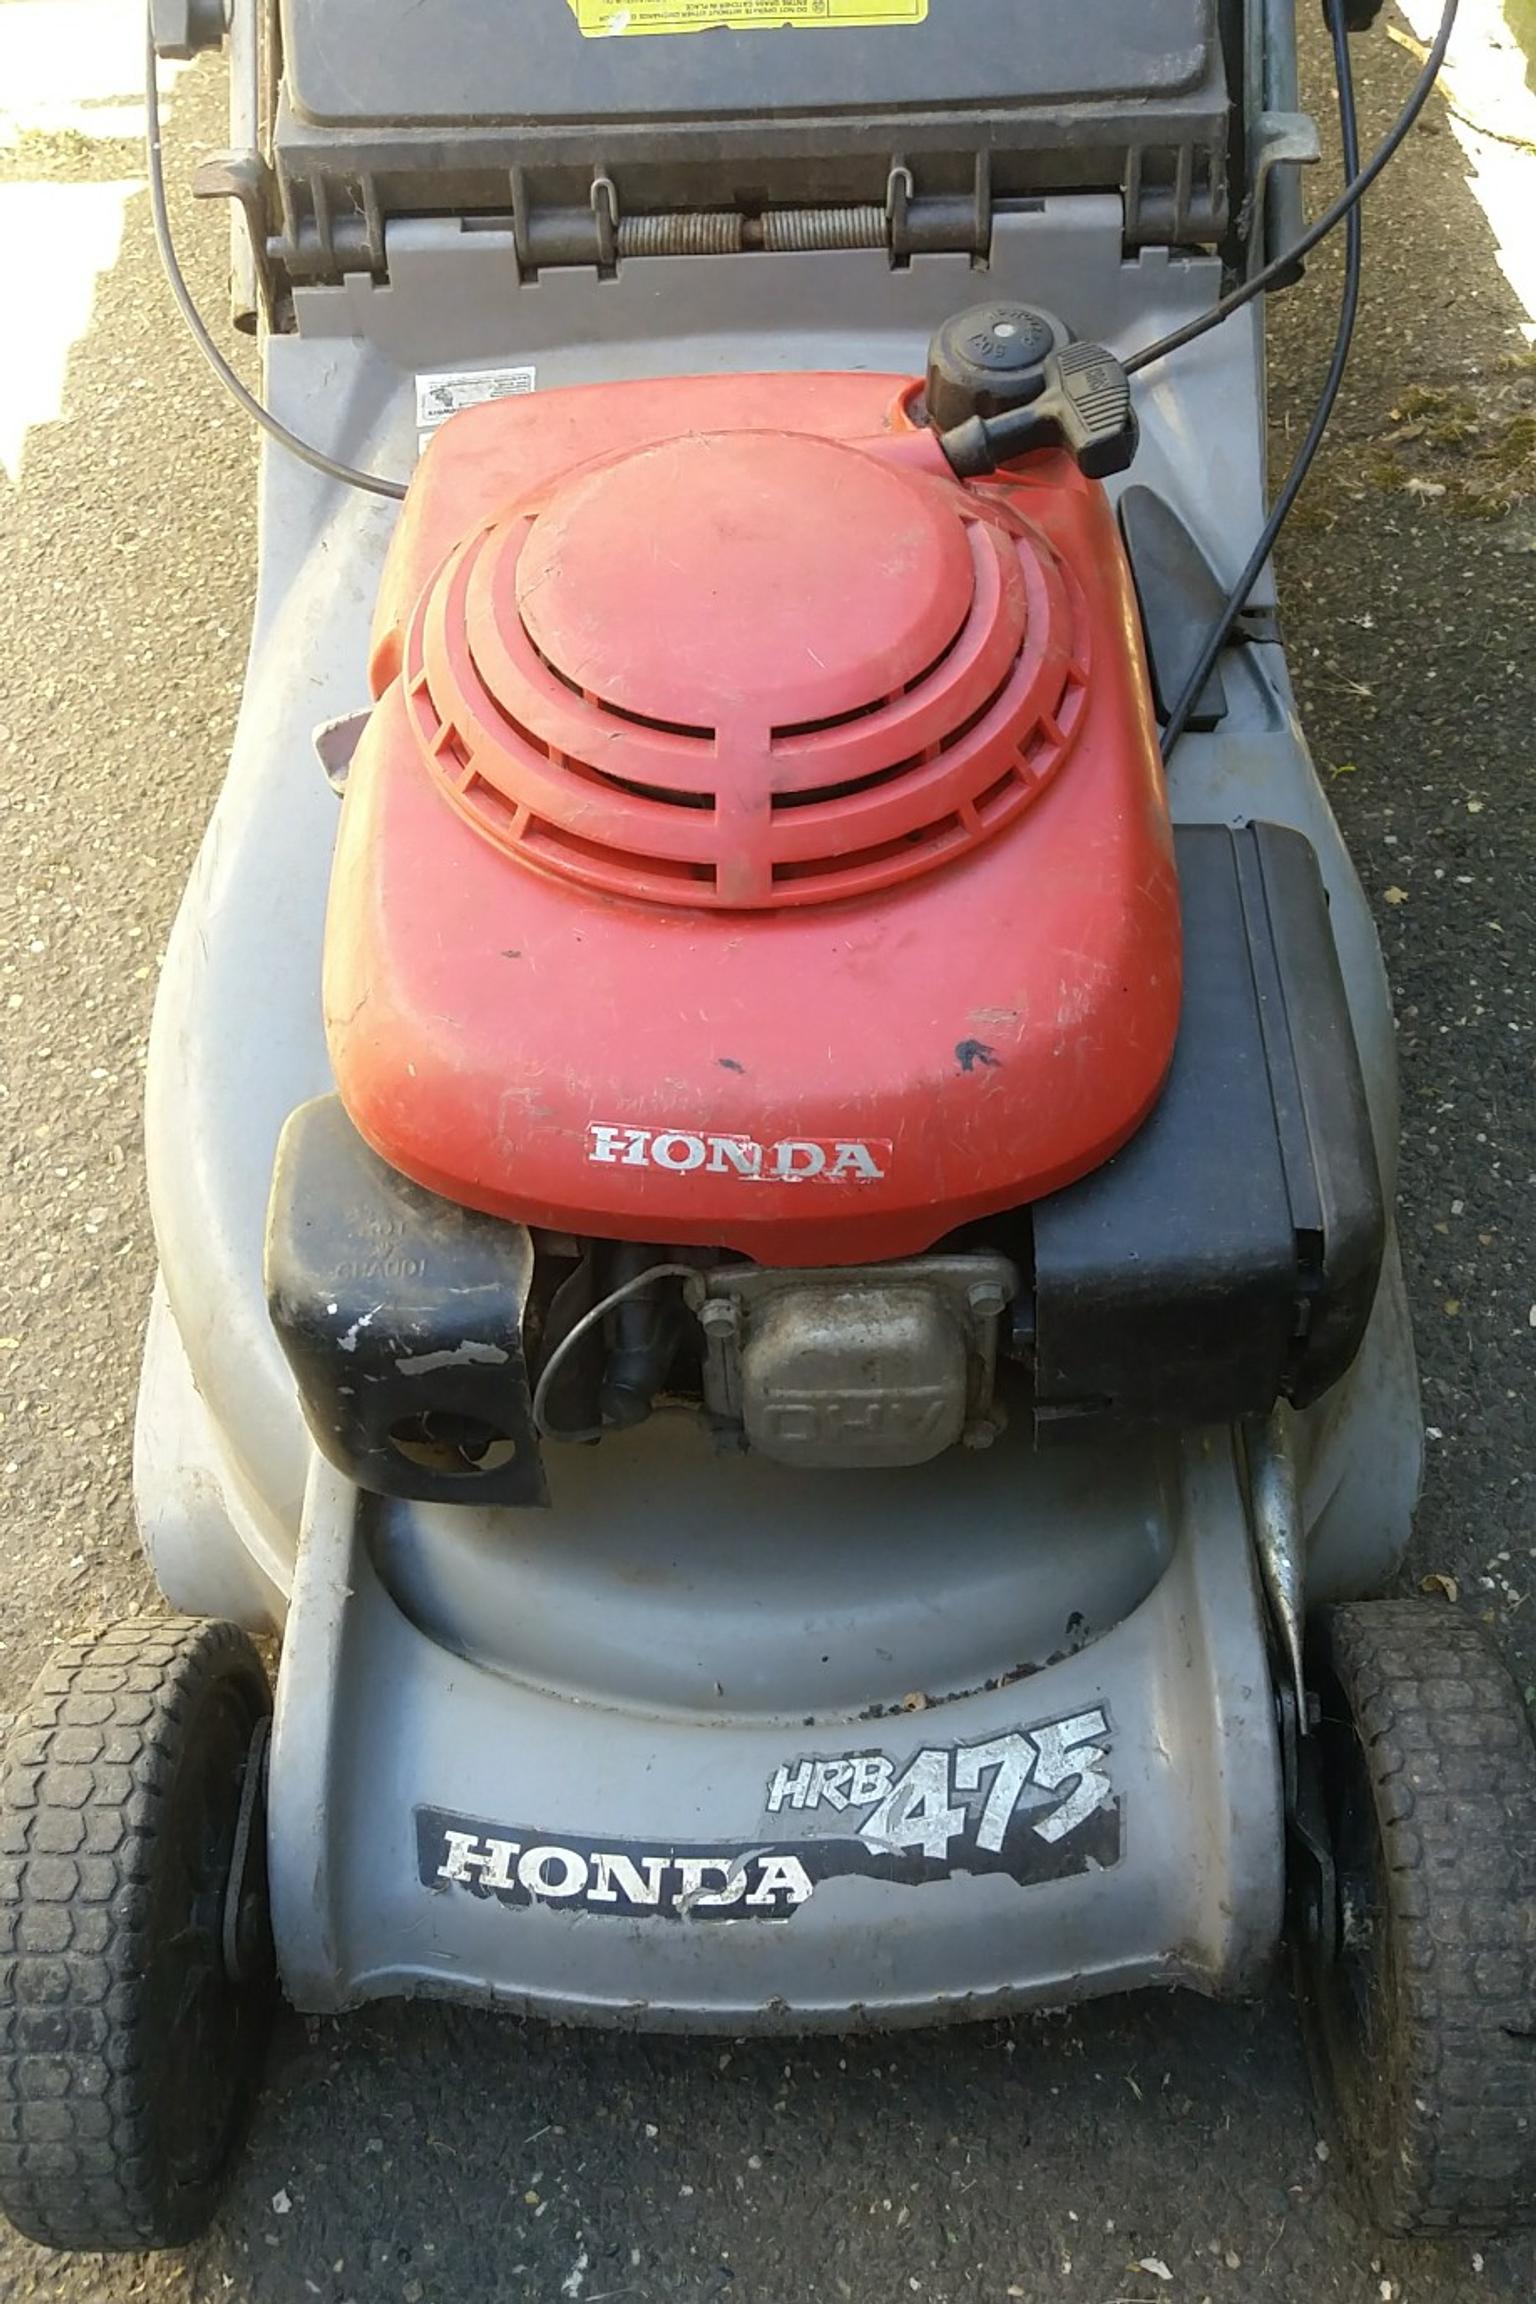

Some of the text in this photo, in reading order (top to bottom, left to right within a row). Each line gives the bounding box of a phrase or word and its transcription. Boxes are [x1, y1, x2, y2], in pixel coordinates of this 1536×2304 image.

[588, 1126, 885, 1178] HONDA
[766, 1709, 1112, 1859] HRB 475
[437, 1831, 814, 1905] HONDA
